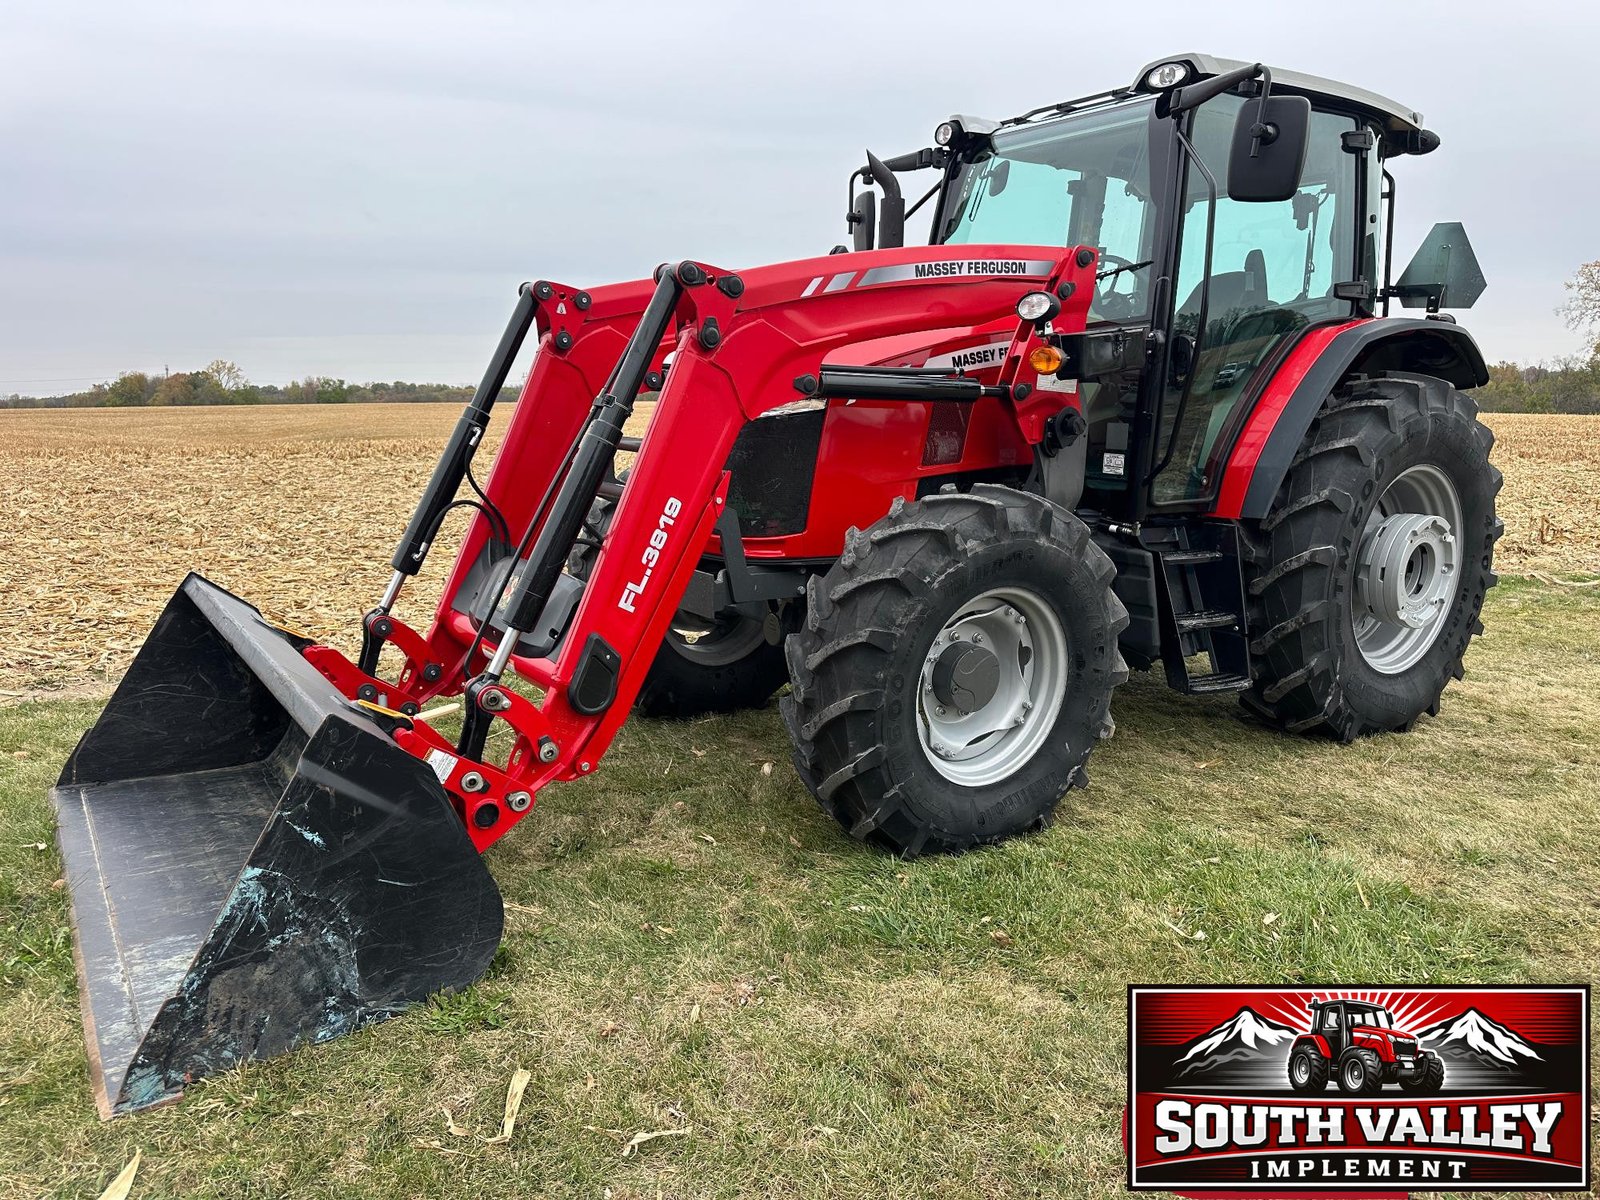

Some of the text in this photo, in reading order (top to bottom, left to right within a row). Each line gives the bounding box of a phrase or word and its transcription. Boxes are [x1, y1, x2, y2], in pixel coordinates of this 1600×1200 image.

[914, 261, 1027, 278] MASSEY FERGUSON
[951, 348, 996, 368] MASSEY
[617, 496, 683, 614] FL.3819
